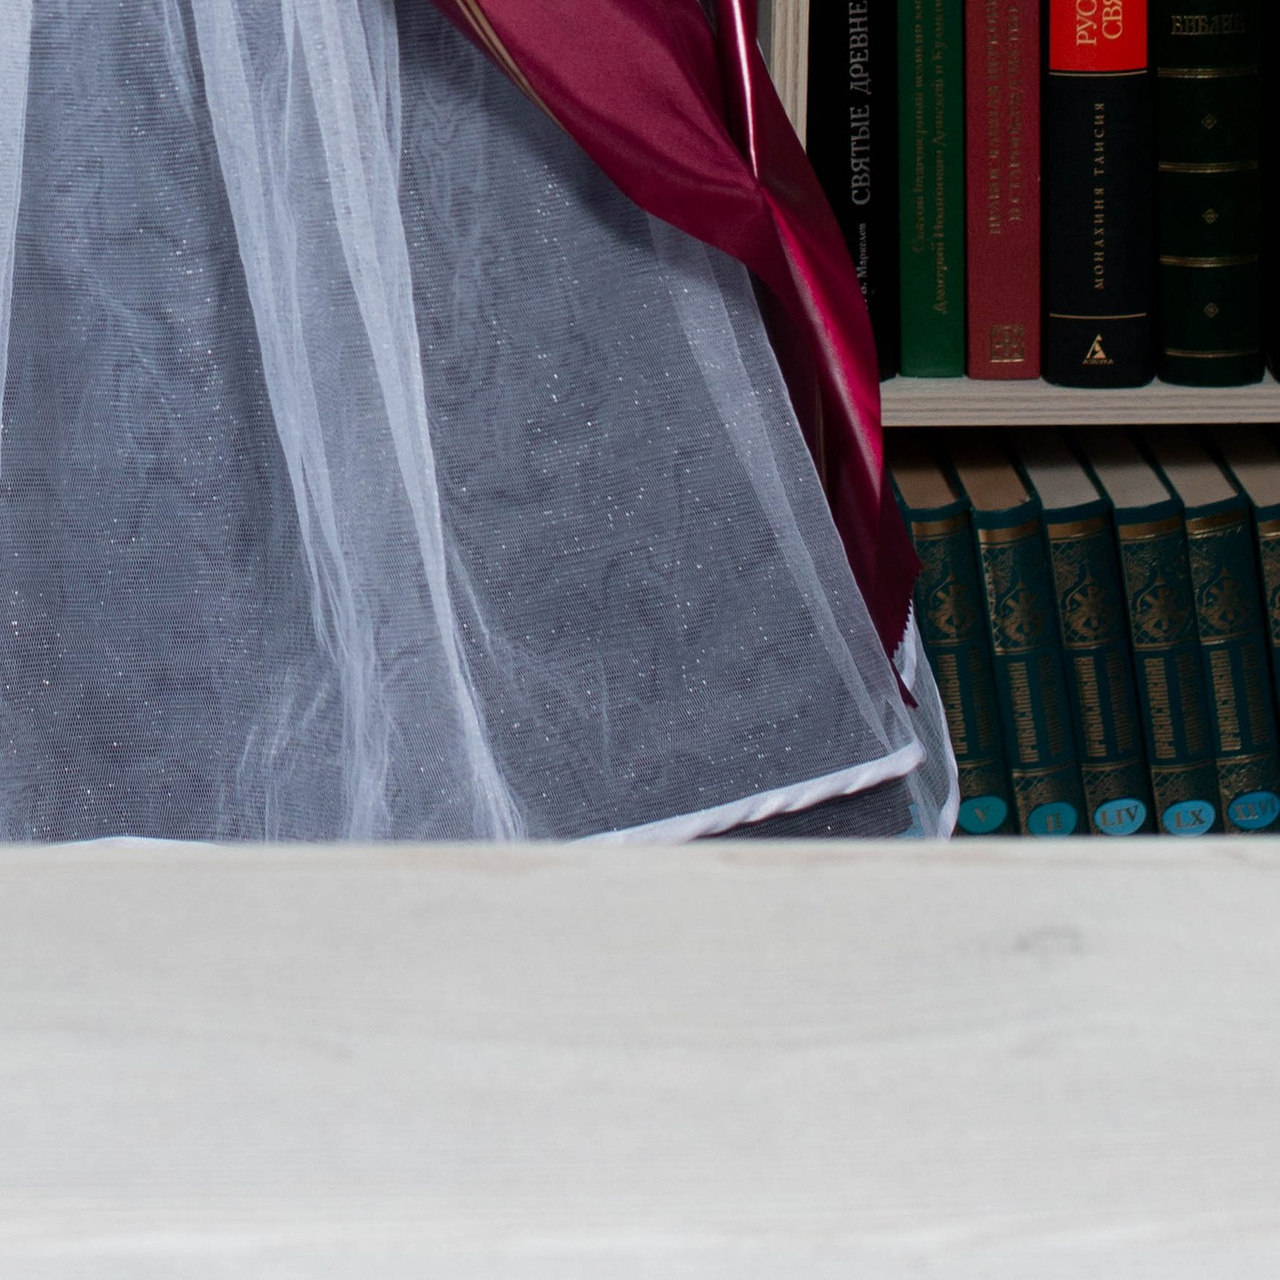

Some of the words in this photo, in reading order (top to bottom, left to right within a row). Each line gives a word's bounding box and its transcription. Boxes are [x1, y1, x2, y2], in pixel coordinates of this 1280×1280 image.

[849, 104, 872, 205] СВЯТЫЕ
[1094, 102, 1105, 176] ТАИСИЯ
[1094, 187, 1105, 289] МОНАХИНЯ
[1100, 805, 1141, 828] LIV
[1174, 808, 1205, 829] LX
